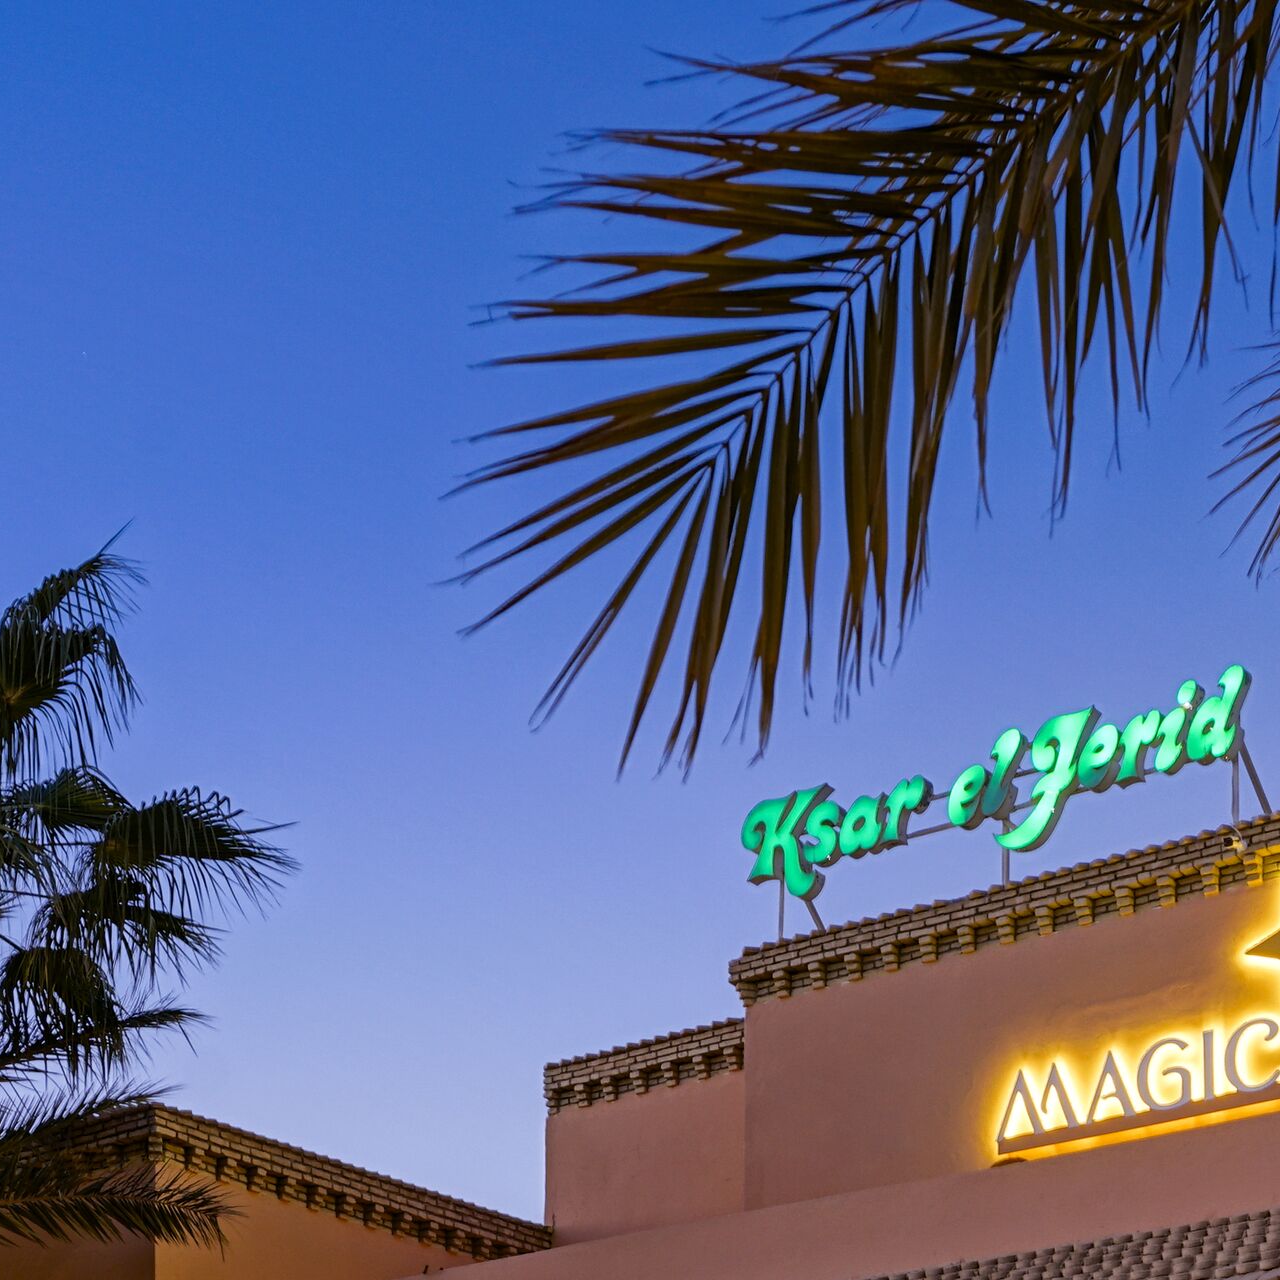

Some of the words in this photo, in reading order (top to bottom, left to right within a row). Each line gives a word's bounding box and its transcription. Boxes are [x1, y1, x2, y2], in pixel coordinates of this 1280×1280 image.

[741, 783, 933, 900] Ksar
[947, 726, 1025, 830] el
[993, 663, 1253, 852] Jerid
